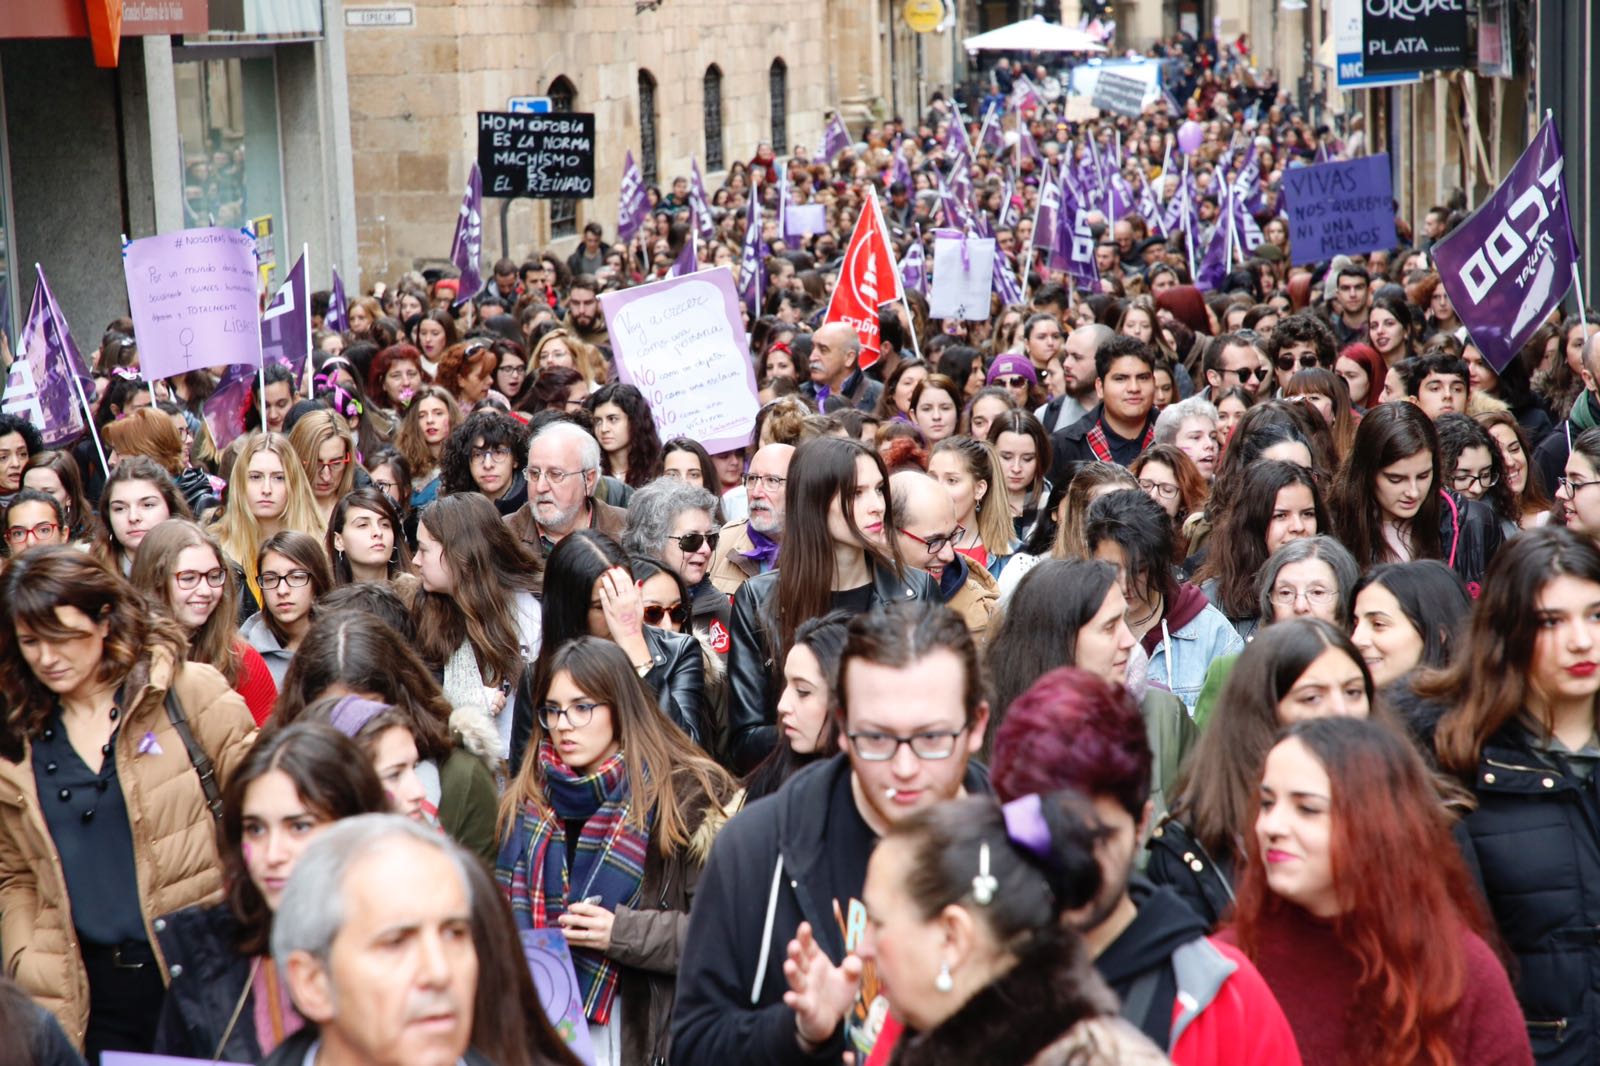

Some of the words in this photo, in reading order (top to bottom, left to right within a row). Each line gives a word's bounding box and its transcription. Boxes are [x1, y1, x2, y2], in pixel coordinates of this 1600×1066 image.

[1368, 37, 1429, 56] PLATA
[493, 131, 512, 147] ES
[517, 134, 535, 148] LA
[543, 135, 590, 151] NORMA
[527, 165, 547, 180] ES
[1290, 166, 1358, 196] VIVAS
[494, 175, 512, 192] EL
[1295, 202, 1326, 221] NOS
[1296, 224, 1313, 240] NI
[1322, 217, 1354, 235] UNA
[1320, 226, 1380, 255] MENOS
[169, 270, 178, 280] un
[184, 263, 216, 275] mundo
[649, 314, 662, 325] a
[632, 363, 656, 390] NO
[655, 405, 677, 432] NO
